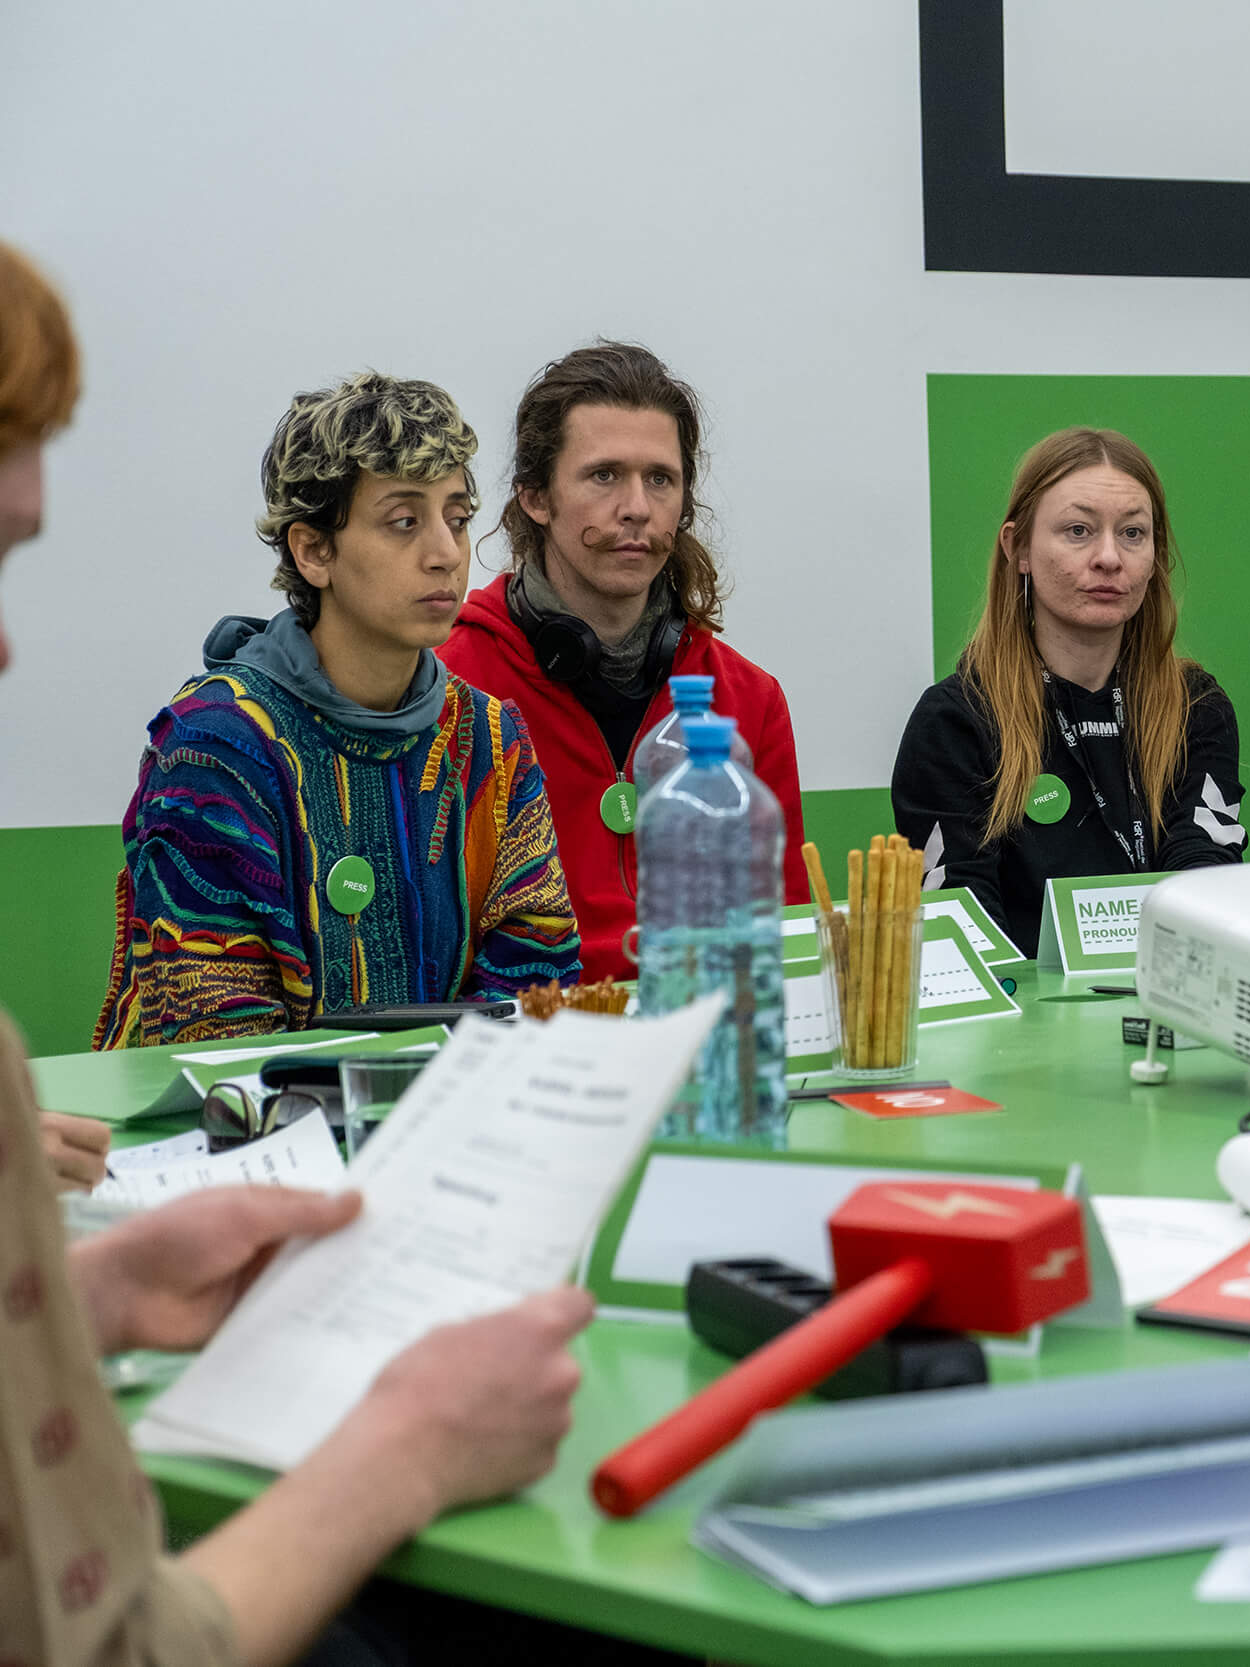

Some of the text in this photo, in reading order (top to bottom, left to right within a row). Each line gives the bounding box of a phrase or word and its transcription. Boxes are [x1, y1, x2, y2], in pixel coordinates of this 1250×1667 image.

[1033, 790, 1059, 805] PRESS
[618, 794, 631, 822] PRESS
[343, 880, 368, 893] PRESS
[1083, 927, 1140, 939] PRONOU
